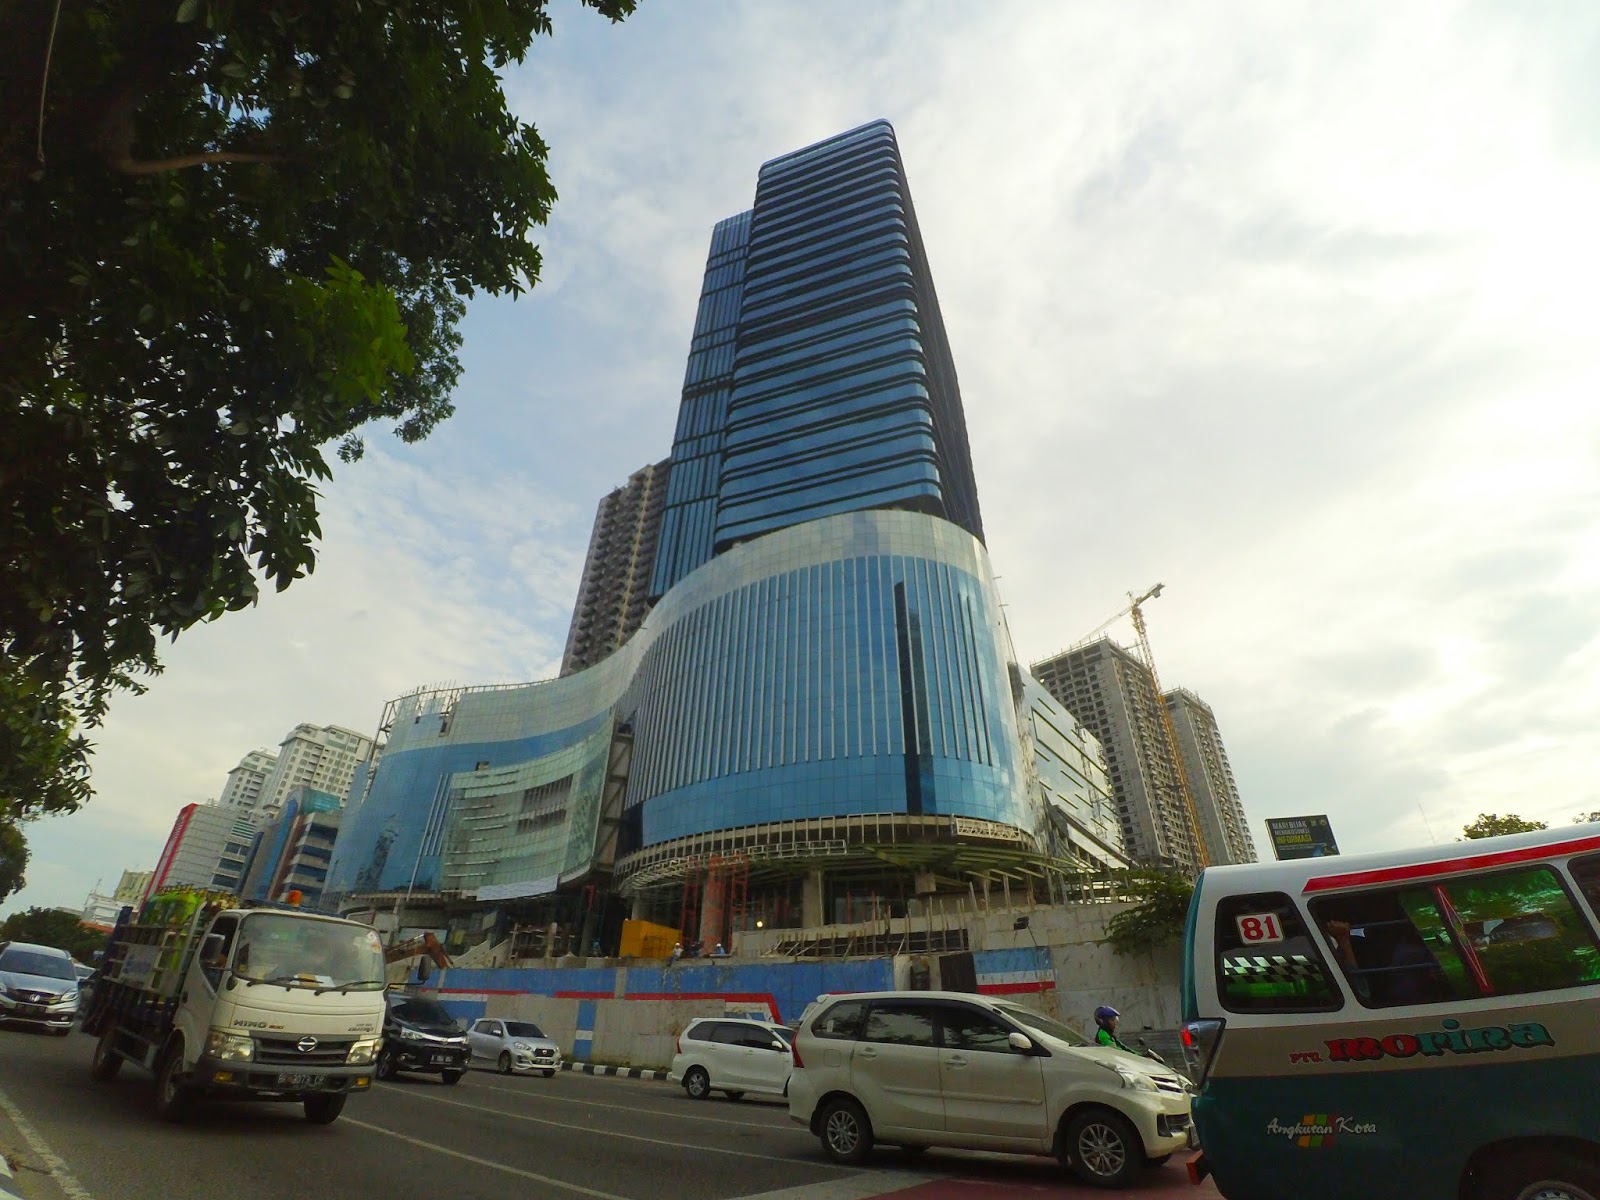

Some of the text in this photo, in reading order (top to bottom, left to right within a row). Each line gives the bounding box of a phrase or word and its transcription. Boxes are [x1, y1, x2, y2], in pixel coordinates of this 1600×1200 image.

[1276, 834, 1313, 844] INFORMASI
[1241, 915, 1280, 940] 81
[233, 1019, 267, 1029] HINO
[1266, 1116, 1377, 1140] Angkutan Kota
